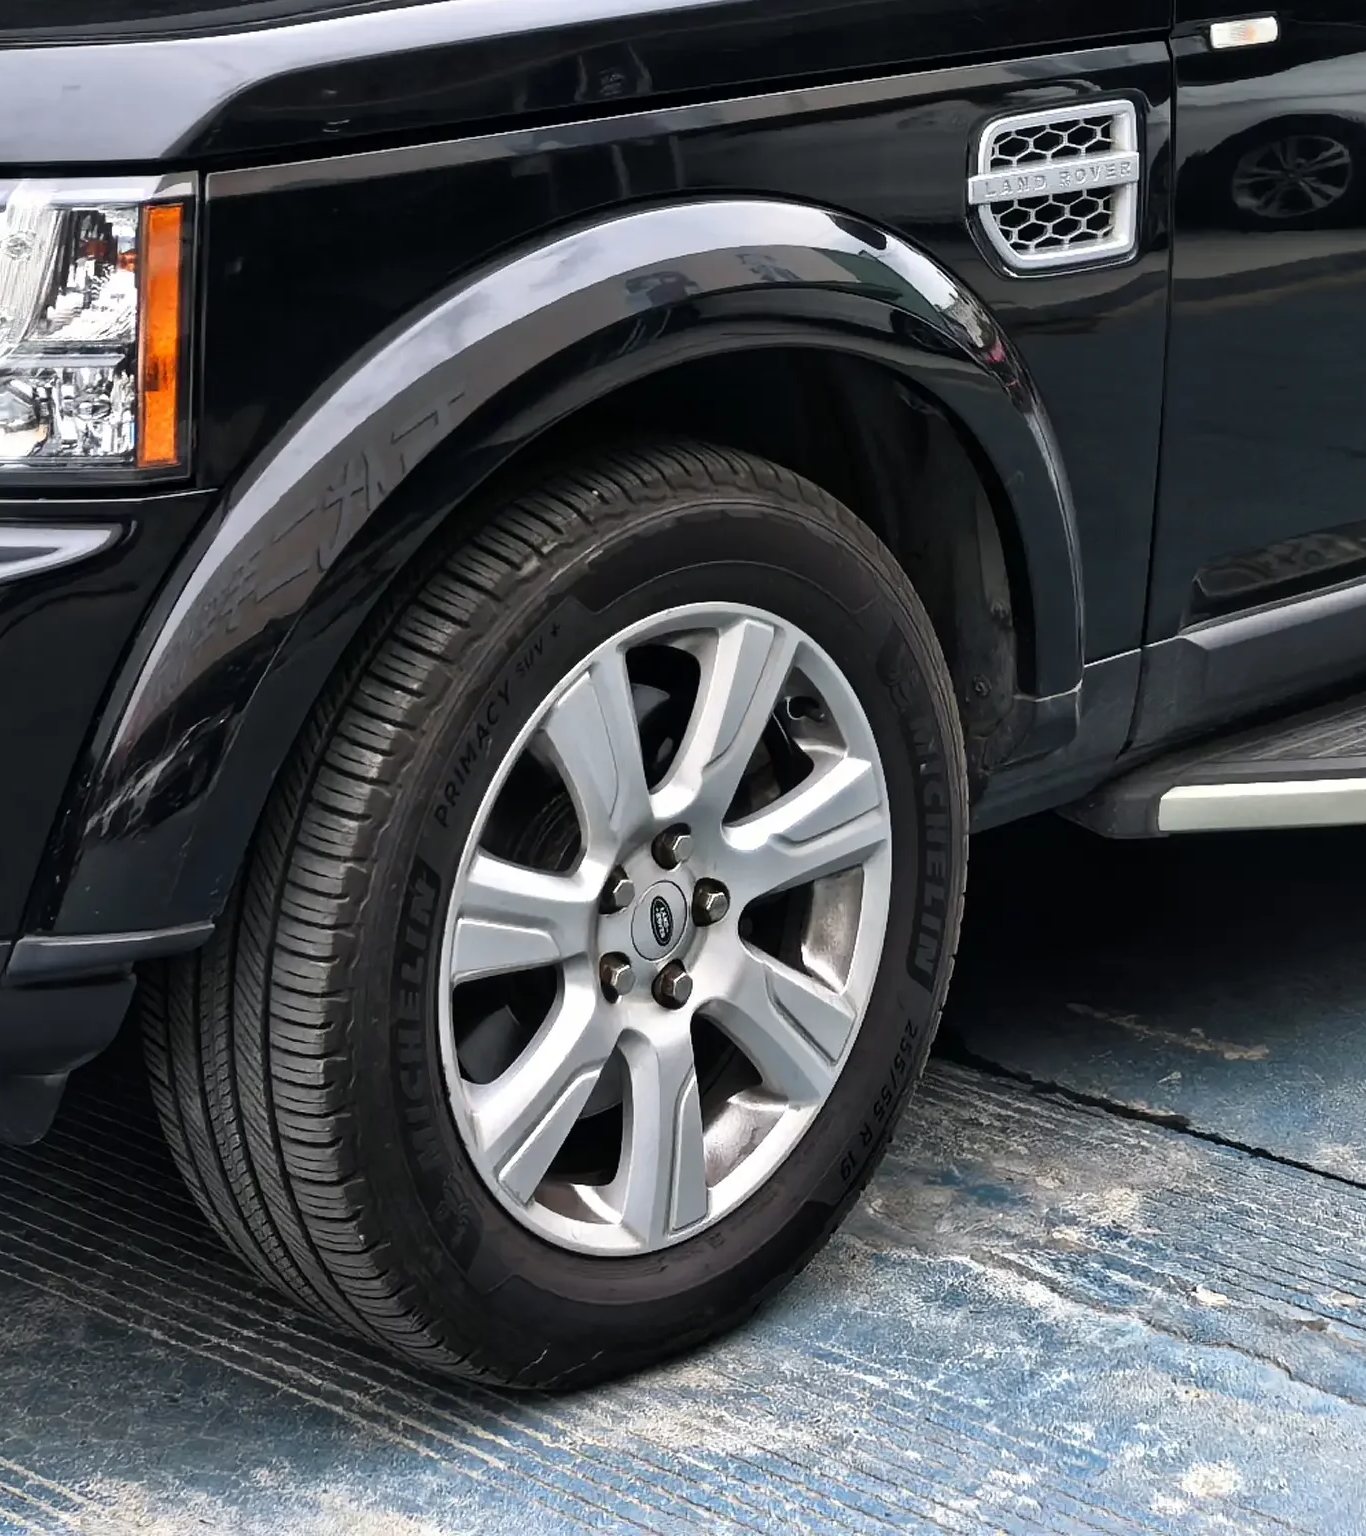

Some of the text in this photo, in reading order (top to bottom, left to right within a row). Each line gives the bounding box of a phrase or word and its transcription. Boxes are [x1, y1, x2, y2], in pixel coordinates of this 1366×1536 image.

[984, 161, 1133, 200] LAND ROVER
[433, 679, 513, 829] PRIMACY
[395, 868, 443, 1171] MICHELIN
[872, 1018, 919, 1123] 255/55
